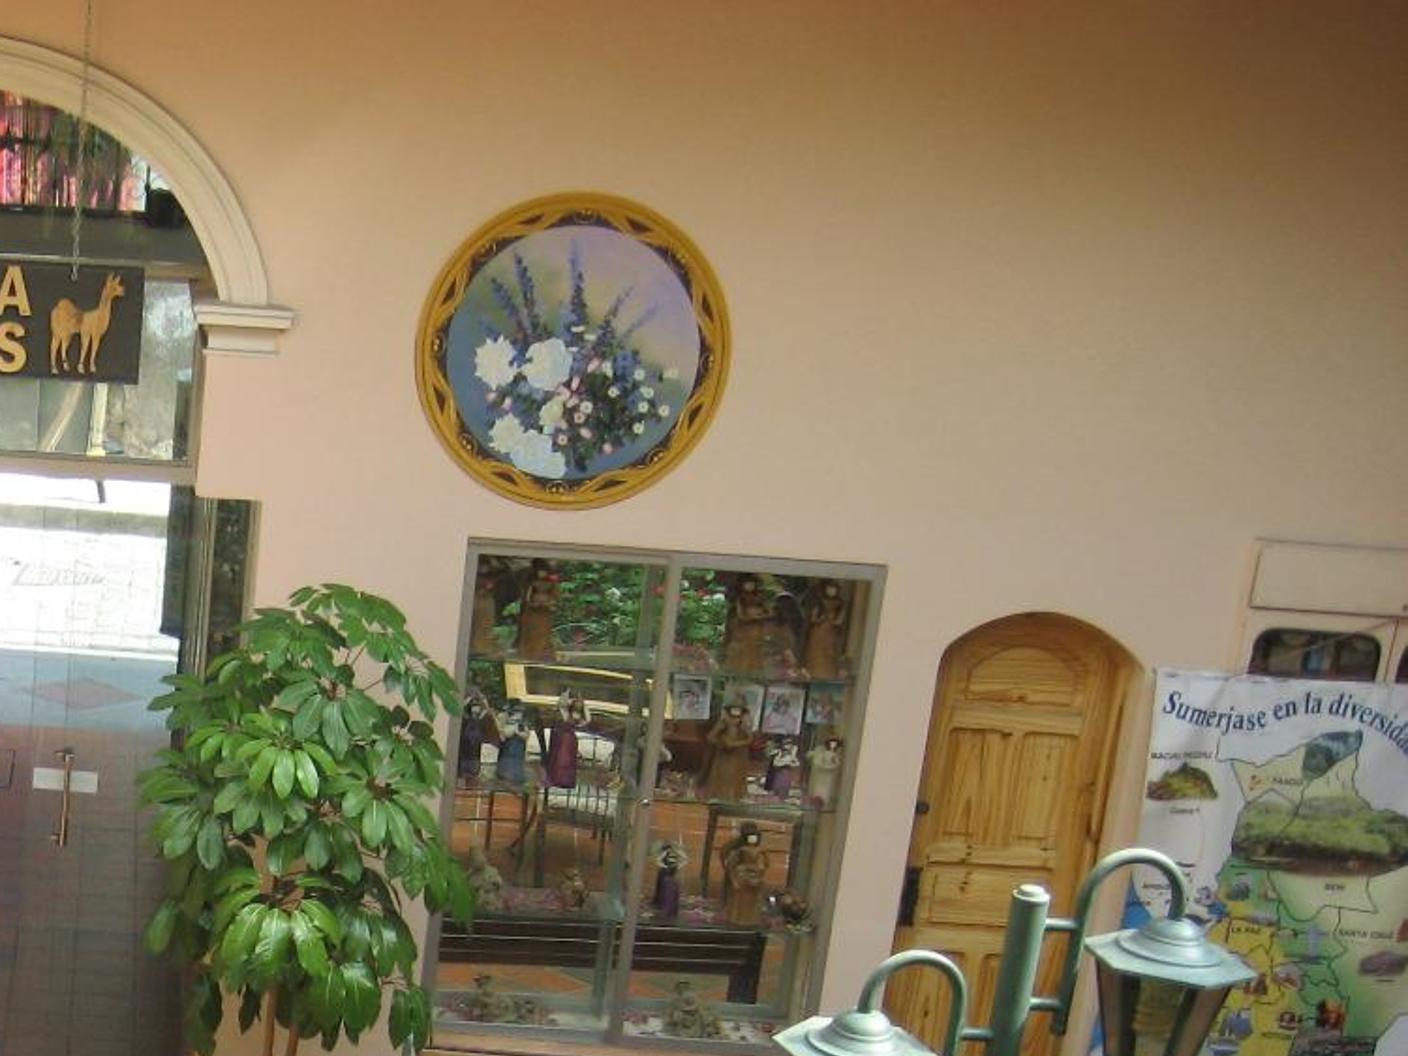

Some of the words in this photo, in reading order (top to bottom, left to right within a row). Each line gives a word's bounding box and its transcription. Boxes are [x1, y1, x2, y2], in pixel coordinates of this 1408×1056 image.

[1163, 690, 1267, 736] Sumerjase
[1273, 700, 1297, 720] en
[1304, 690, 1322, 715] la
